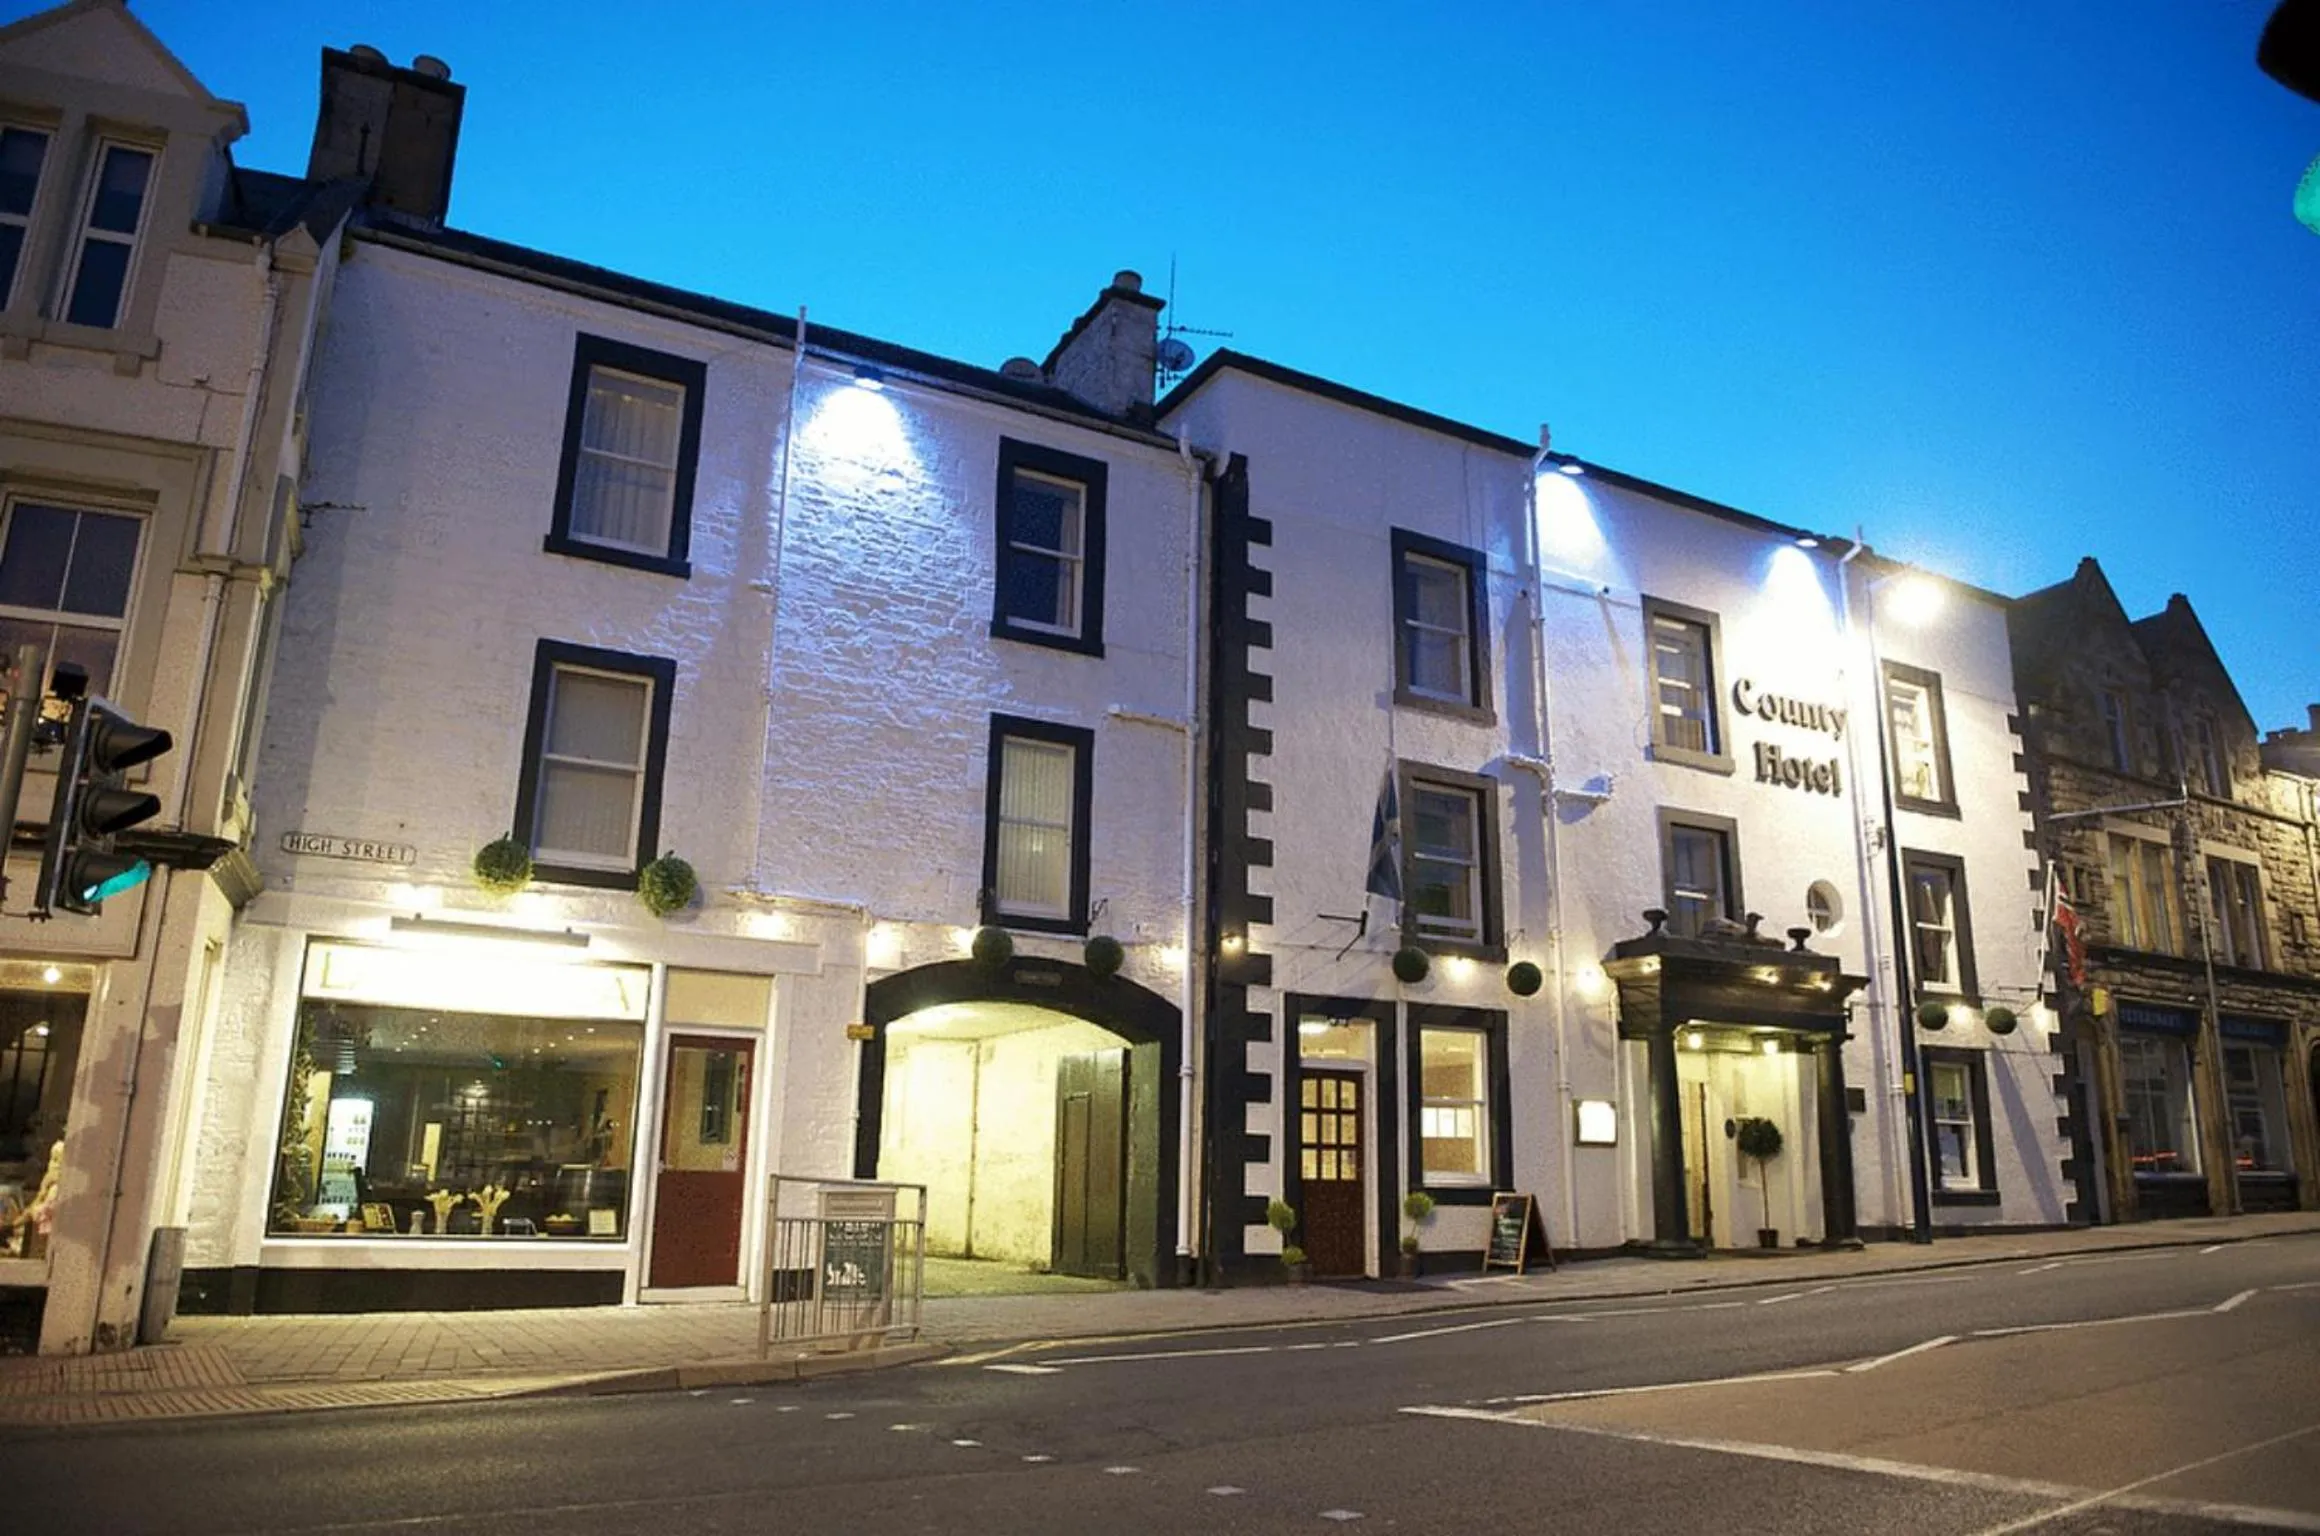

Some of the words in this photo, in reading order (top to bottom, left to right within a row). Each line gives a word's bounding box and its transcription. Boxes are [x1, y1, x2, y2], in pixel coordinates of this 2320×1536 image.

[1732, 677, 1848, 741] County
[1753, 739, 1842, 798] Hotel
[289, 834, 332, 853] HIGH
[342, 841, 406, 861] STREET
